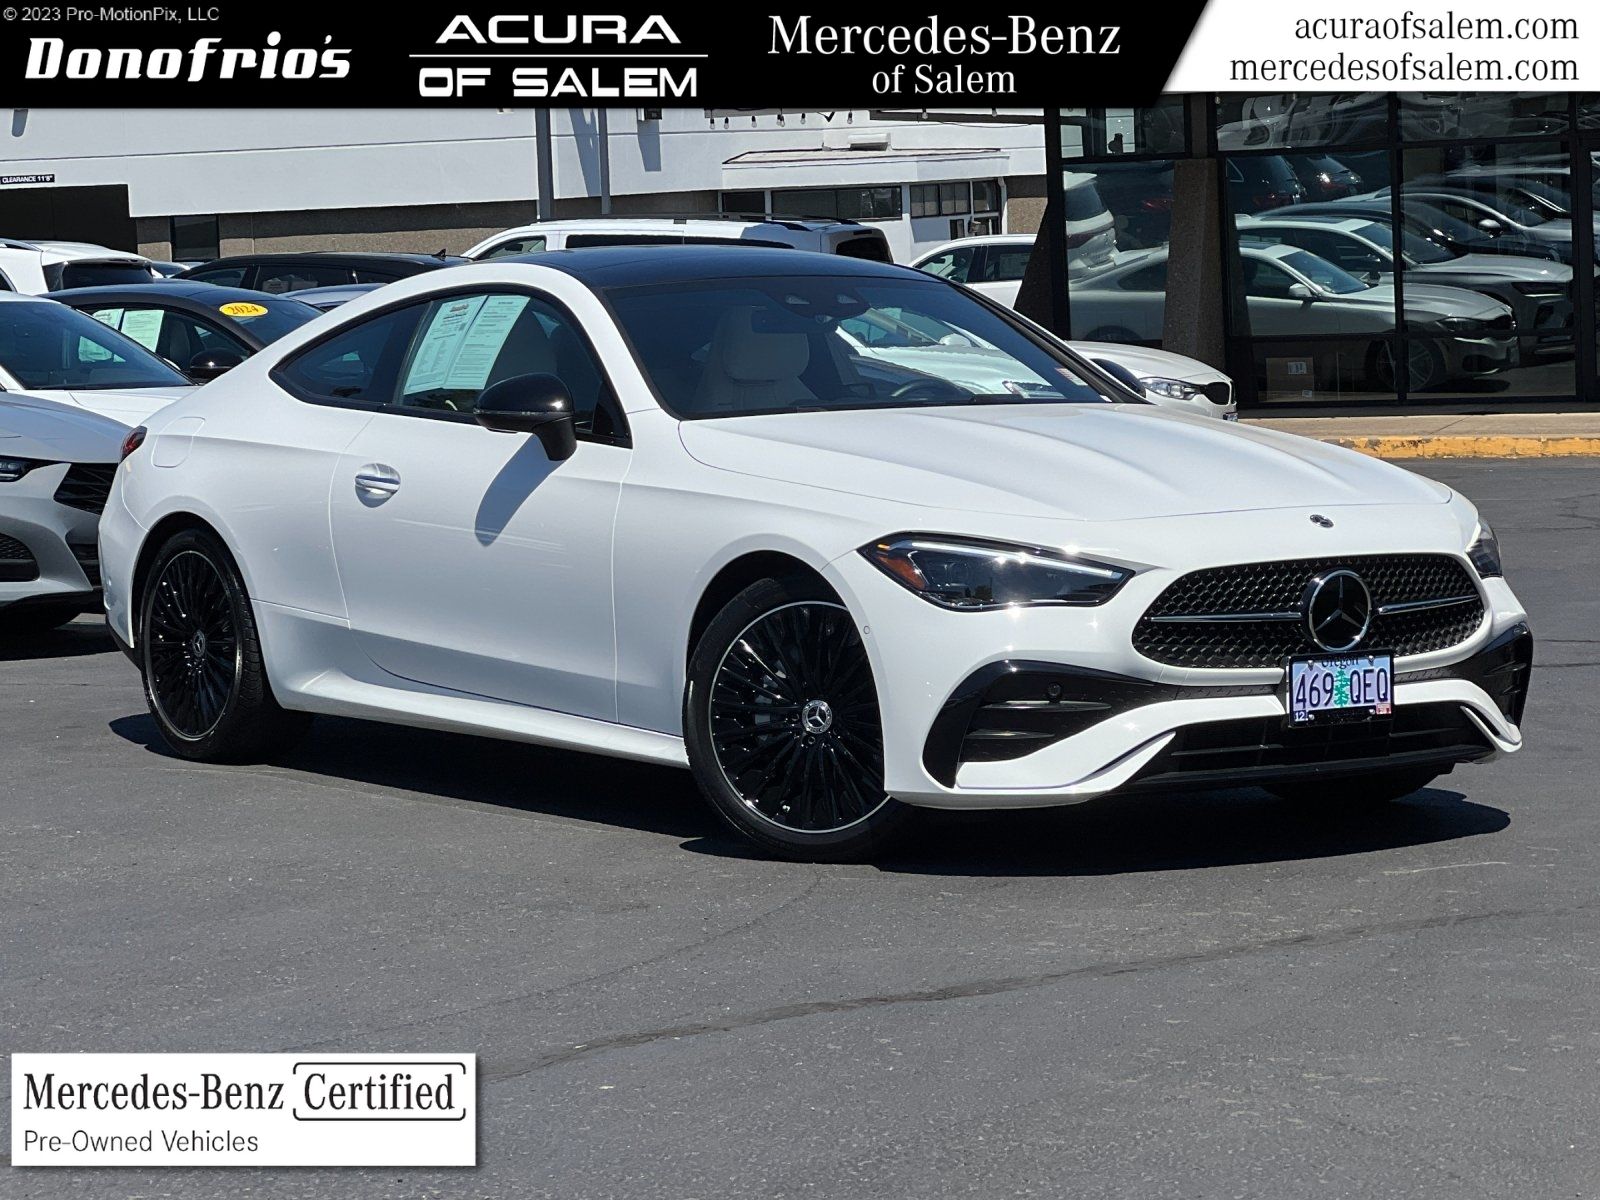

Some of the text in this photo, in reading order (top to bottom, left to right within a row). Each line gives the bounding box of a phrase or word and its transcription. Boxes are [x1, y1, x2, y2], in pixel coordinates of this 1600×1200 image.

[2, 175, 36, 183] CLEARANCE
[227, 305, 258, 314] 2024
[1295, 668, 1388, 709] 469 QEQ
